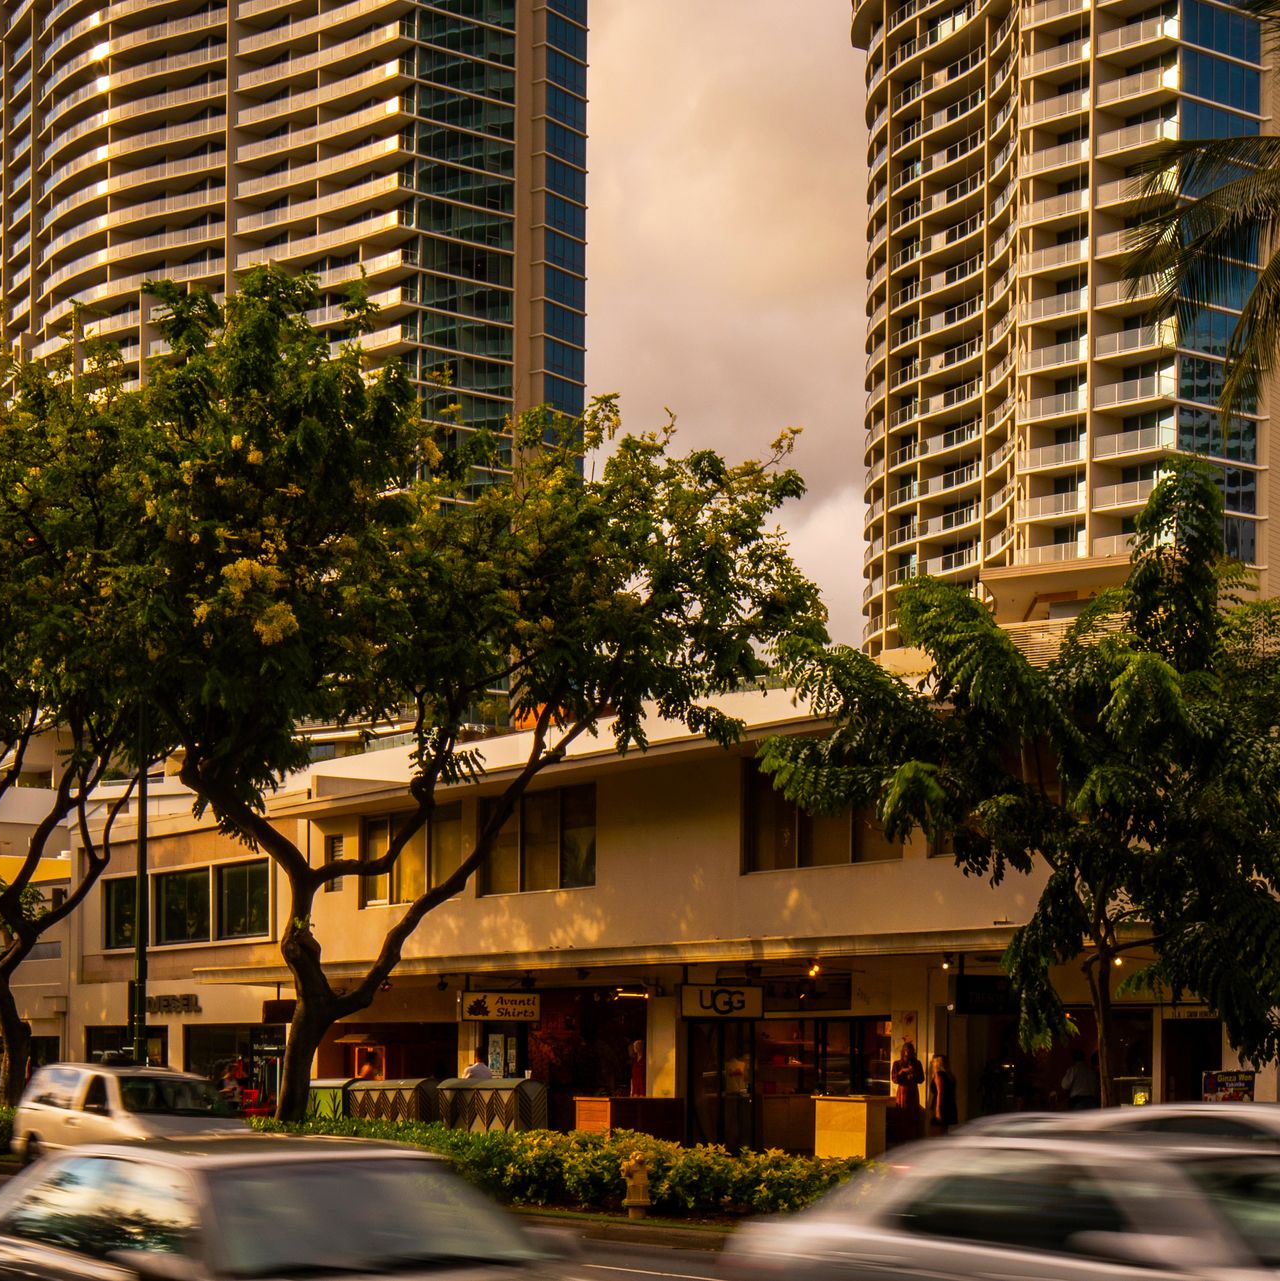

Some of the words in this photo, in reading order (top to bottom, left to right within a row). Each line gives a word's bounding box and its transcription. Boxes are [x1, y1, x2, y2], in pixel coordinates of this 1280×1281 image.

[495, 996, 536, 1006] Avanti
[699, 988, 746, 1015] UGG
[496, 1007, 535, 1017] Shirts
[1217, 1074, 1237, 1083] Ginza
